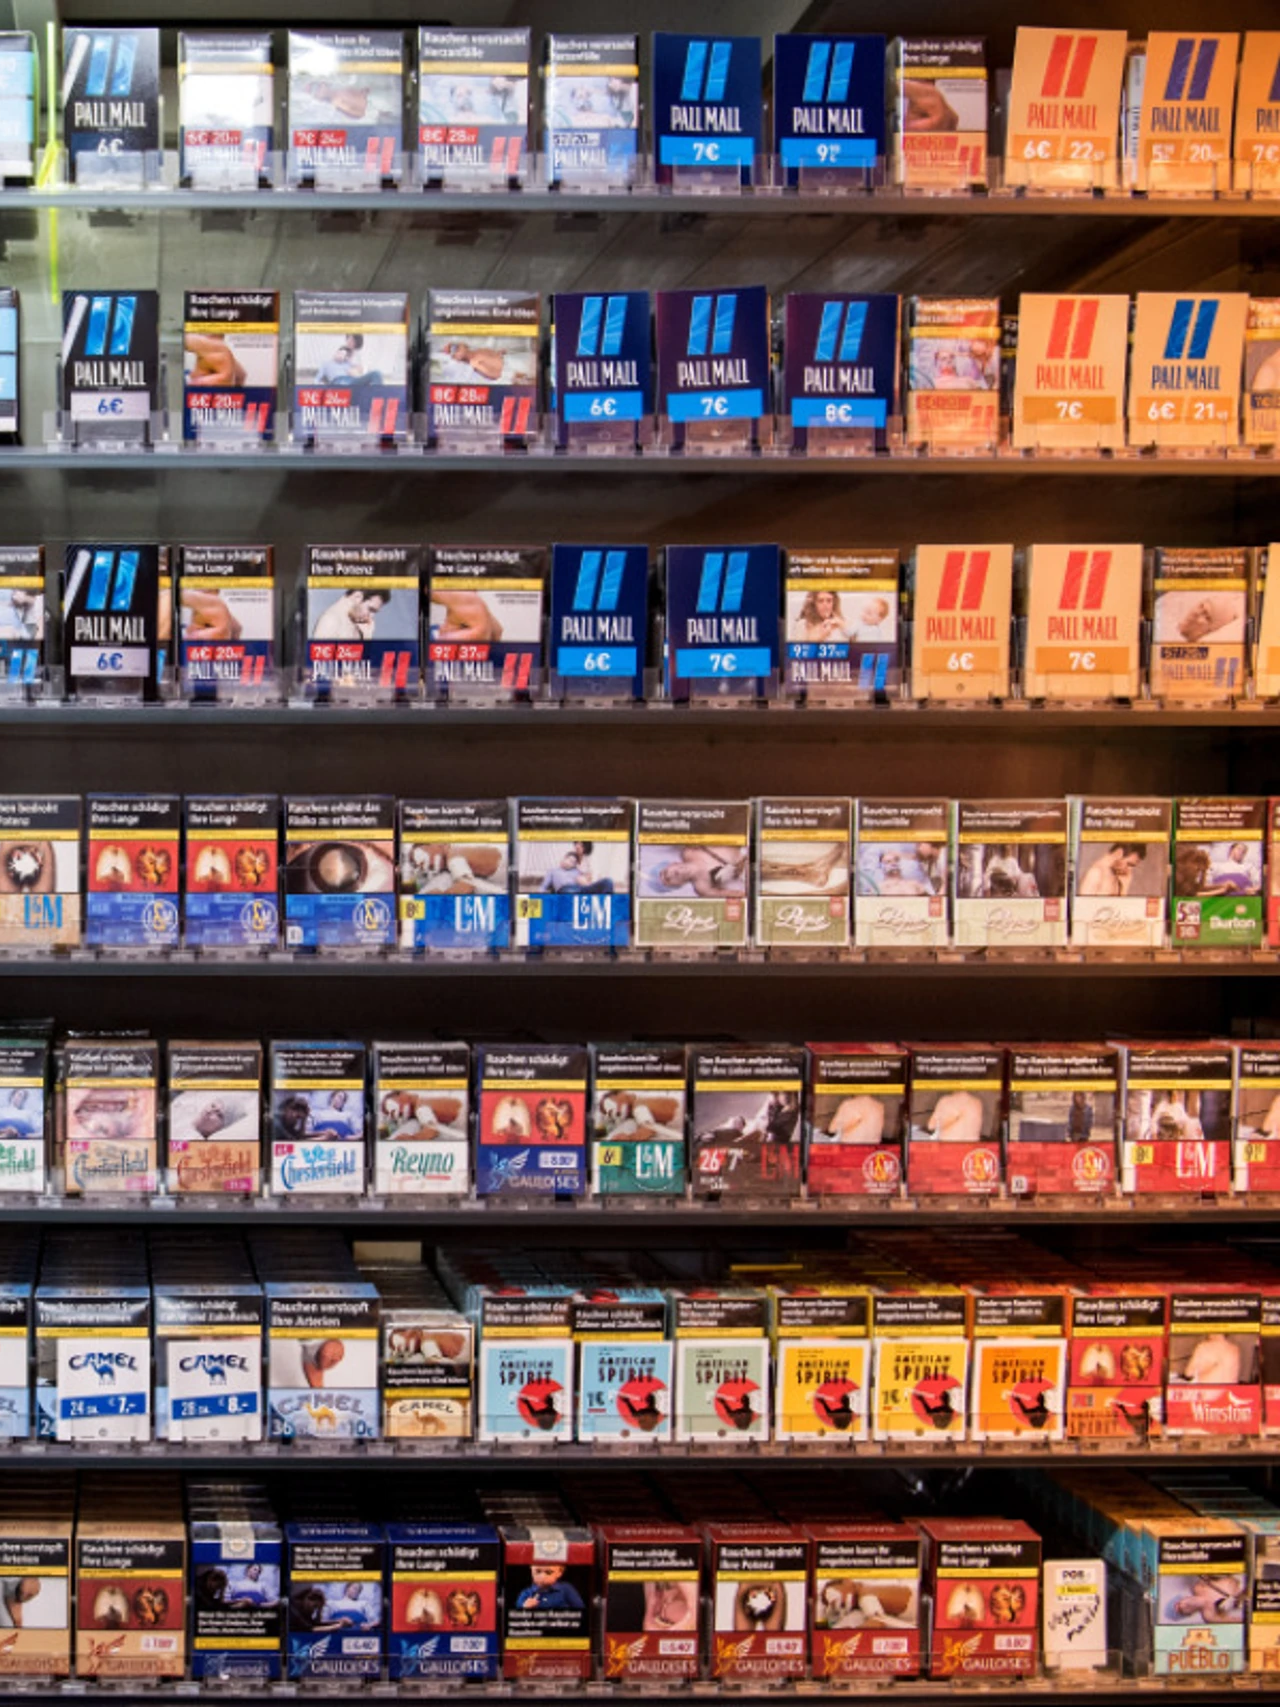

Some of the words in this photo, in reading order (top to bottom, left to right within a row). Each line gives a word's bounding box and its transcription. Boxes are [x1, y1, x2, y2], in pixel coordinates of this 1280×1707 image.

[74, 102, 108, 127] PALL
[110, 102, 146, 127] MALL
[670, 105, 703, 130] PALL
[705, 107, 742, 132] MALL
[793, 107, 824, 133] PALL
[826, 107, 864, 134] MALL
[1026, 102, 1058, 130] PALL
[1061, 102, 1097, 131] MALL
[1151, 106, 1181, 131] PALL
[1184, 107, 1220, 132] MALL
[74, 361, 108, 386] PALL
[110, 361, 147, 387] MALL
[567, 361, 599, 387] PALL
[601, 361, 638, 387] MALL
[677, 359, 710, 386] PALL
[712, 360, 750, 386] MALL
[804, 366, 837, 392] PALL
[838, 366, 876, 393] MALL
[1036, 366, 1069, 391] PALL
[1070, 366, 1105, 391] MALL
[1151, 366, 1181, 391] PALL
[1184, 366, 1220, 391] MALL
[97, 397, 124, 416] 6€
[590, 397, 616, 416] 6€
[701, 396, 728, 415] 7€
[1056, 401, 1082, 419] 7€
[1148, 402, 1175, 420] 6€
[311, 548, 360, 562] Rauchen
[436, 549, 476, 563] Rauchen
[478, 549, 520, 566] schädigt
[311, 563, 332, 576] Ihre
[335, 563, 374, 577] Potenz
[74, 616, 108, 642] PALL
[110, 616, 147, 643] MALL
[562, 616, 595, 641] PALL
[597, 616, 634, 642] MALL
[687, 618, 720, 643] PALL
[722, 617, 758, 643] MALL
[927, 616, 960, 641] PALL
[961, 616, 997, 641] MALL
[1048, 616, 1081, 641] PALL
[1083, 616, 1119, 641] MALL
[97, 653, 124, 671] 6€
[584, 653, 611, 671] 6€
[710, 654, 737, 672] 7€
[946, 653, 974, 671] 6€
[1068, 653, 1096, 671] 7€
[24, 895, 63, 930] L&M
[455, 894, 496, 933] L&M
[573, 895, 612, 930] L&M
[662, 904, 719, 936] Pepe
[775, 904, 831, 936] Pepe
[177, 1147, 253, 1190] Chesterfield
[280, 1147, 356, 1189] Chesterfield
[390, 1147, 455, 1180] Reyno
[635, 1144, 674, 1180] L&M
[1176, 1142, 1216, 1179] L&M
[317, 1299, 370, 1317] verstopft
[68, 1351, 139, 1370] CAMEL
[179, 1351, 250, 1370] CAMEL
[499, 1370, 553, 1385] SPIRIT
[597, 1366, 655, 1382] SPIRIT
[695, 1370, 747, 1384] SPIRIT
[278, 1394, 364, 1416] CAMEL
[1191, 1402, 1252, 1423] Winston
[309, 1659, 380, 1674] GAULOISES
[628, 1658, 698, 1674] GAULOISES
[1167, 1650, 1230, 1671] PUEBLO
